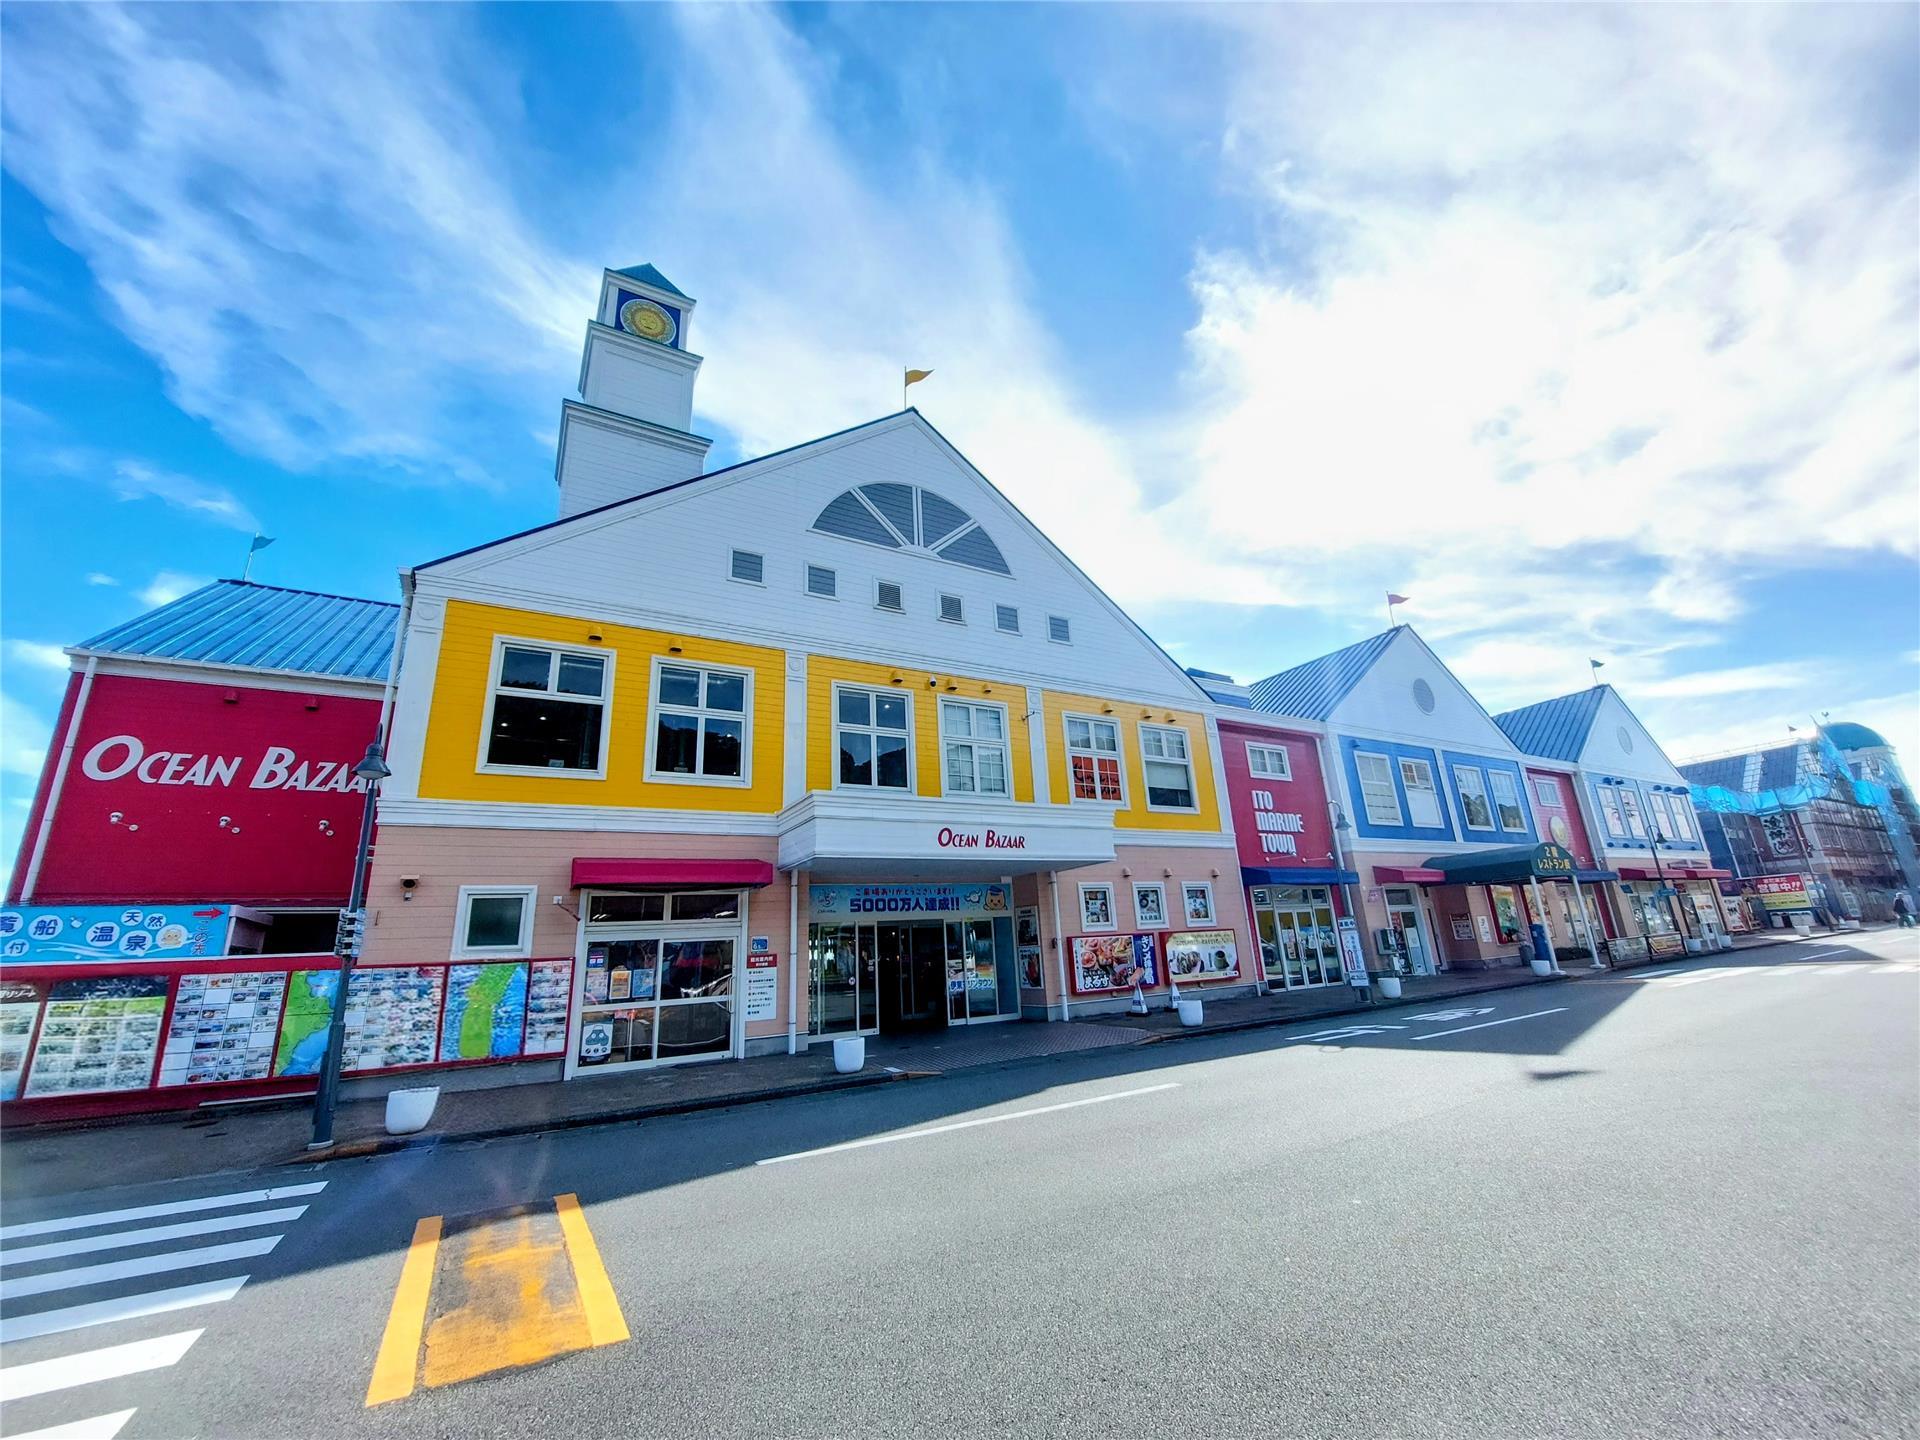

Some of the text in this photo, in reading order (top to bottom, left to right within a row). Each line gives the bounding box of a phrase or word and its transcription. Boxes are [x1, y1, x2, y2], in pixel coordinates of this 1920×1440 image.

[82, 735, 382, 794] OCEAN BAZAA
[1251, 790, 1273, 810] ITO
[1254, 811, 1305, 832] MARINE
[938, 827, 1025, 848] OCEAN BAZAAR
[1258, 833, 1297, 855] TOWN
[850, 897, 960, 913] 5000万人達成!!
